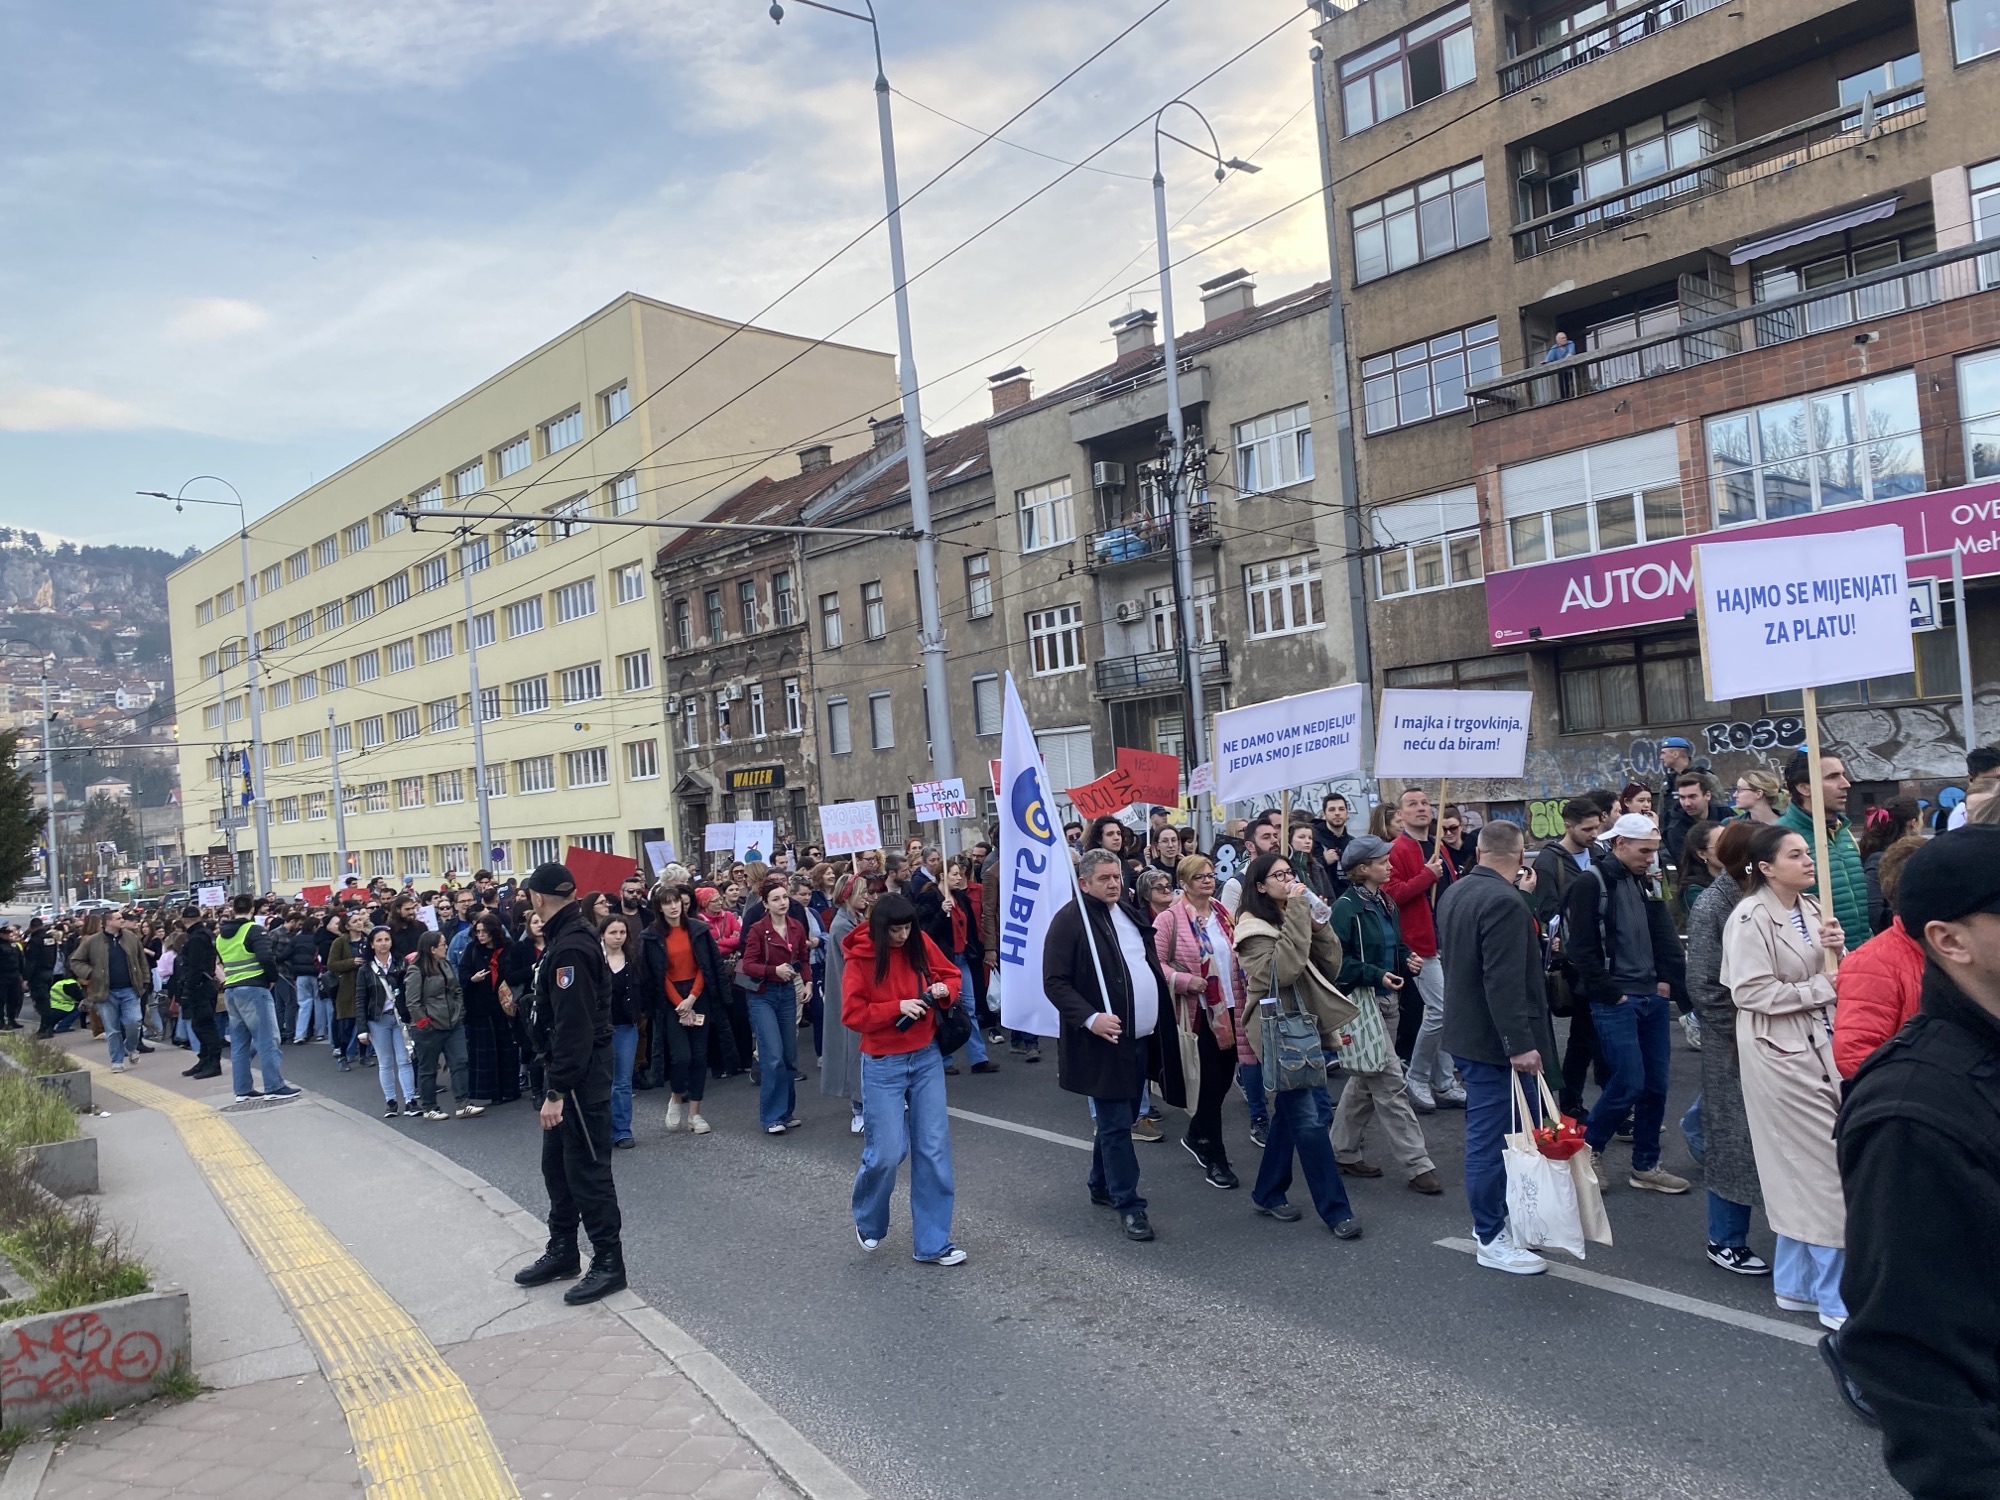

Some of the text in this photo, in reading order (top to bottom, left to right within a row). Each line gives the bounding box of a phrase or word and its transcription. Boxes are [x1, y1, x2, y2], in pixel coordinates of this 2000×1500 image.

[1716, 574, 1897, 615] HAJMO SE MIJENJATI
[1764, 614, 1856, 645] ZA PLATU!
[1223, 713, 1356, 754] NE DAMO VAM NEDJELJU!
[1394, 715, 1523, 733] I majka i trgovkinja,
[1229, 732, 1350, 773] JEDVA SMO JE IZBORILI
[1403, 737, 1500, 750] neću da biram!
[733, 769, 773, 788] WALTER
[913, 781, 944, 794] ISTI
[931, 789, 959, 802] POSAO
[1072, 785, 1115, 814] HOĆU
[823, 805, 873, 826] MORE
[827, 823, 876, 849] MARŠ
